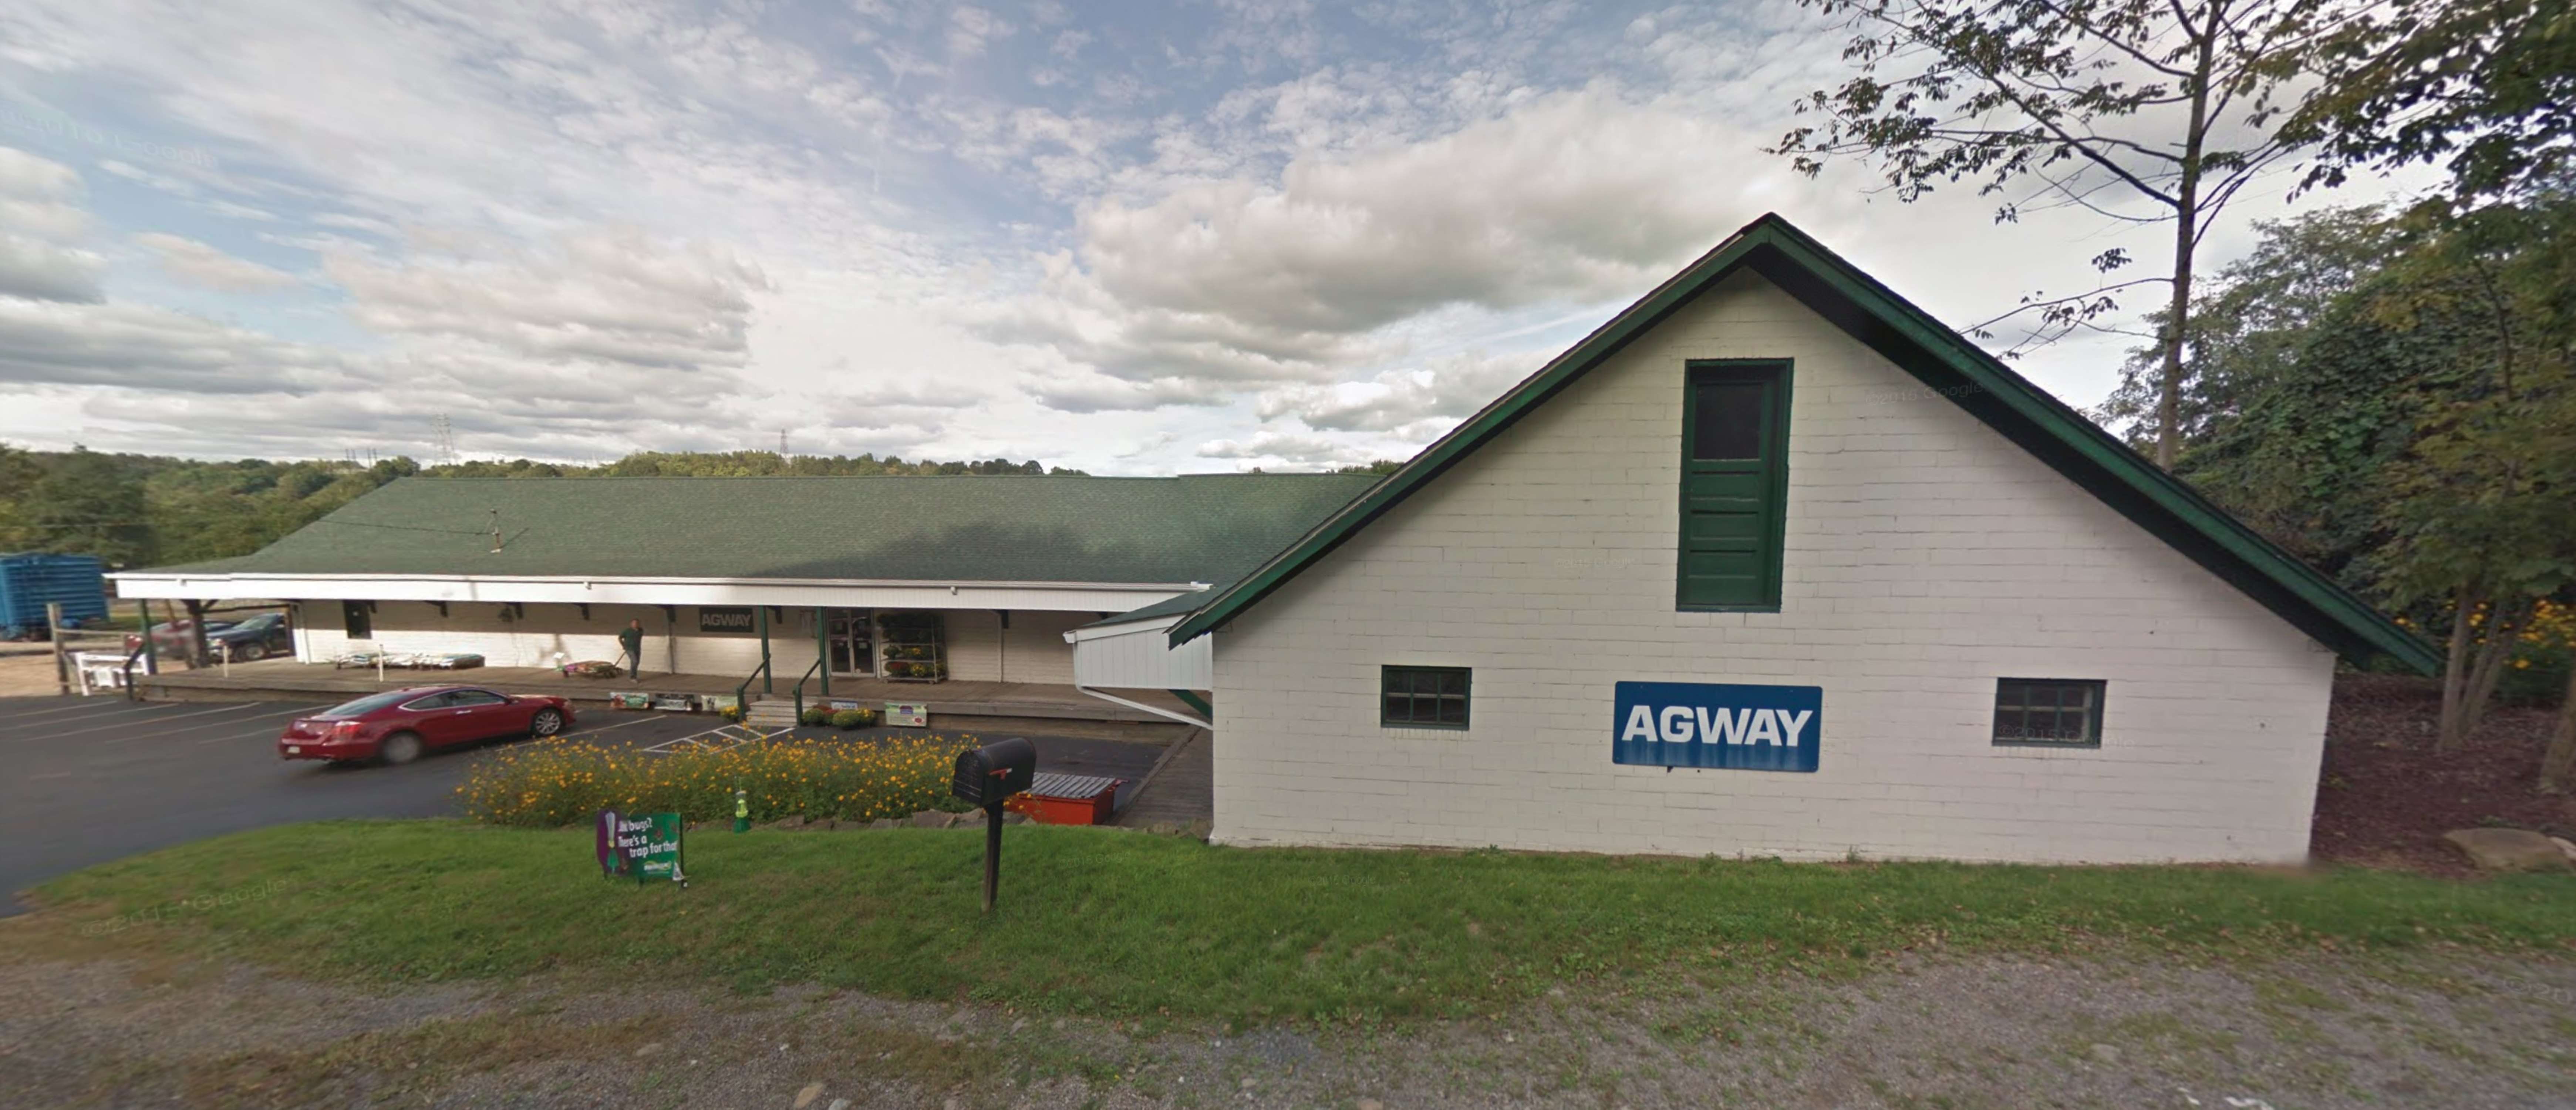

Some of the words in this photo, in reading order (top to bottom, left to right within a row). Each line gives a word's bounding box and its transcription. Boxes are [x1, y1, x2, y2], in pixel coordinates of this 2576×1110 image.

[702, 614, 751, 626] AGWAY
[1621, 705, 1813, 747] AGWAY
[628, 817, 653, 831] bugs?
[641, 835, 647, 844] a
[629, 846, 649, 858] trap
[650, 842, 662, 854] for
